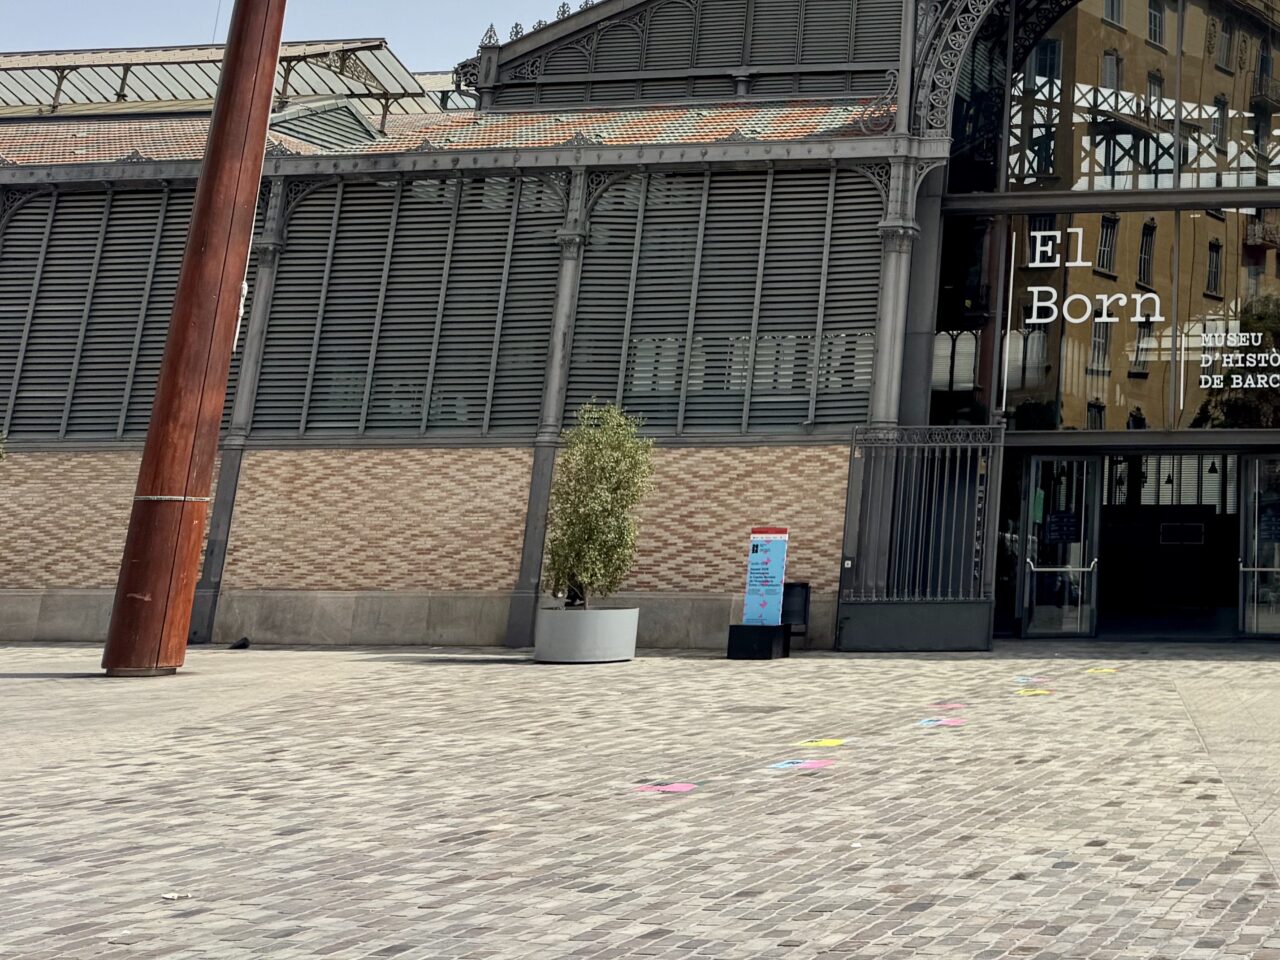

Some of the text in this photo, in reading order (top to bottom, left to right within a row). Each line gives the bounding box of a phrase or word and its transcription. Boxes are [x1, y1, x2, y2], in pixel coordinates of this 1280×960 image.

[1028, 227, 1092, 268] El
[1025, 286, 1165, 324] Born
[1200, 332, 1263, 347] MUSEU
[1199, 374, 1224, 388] DE
